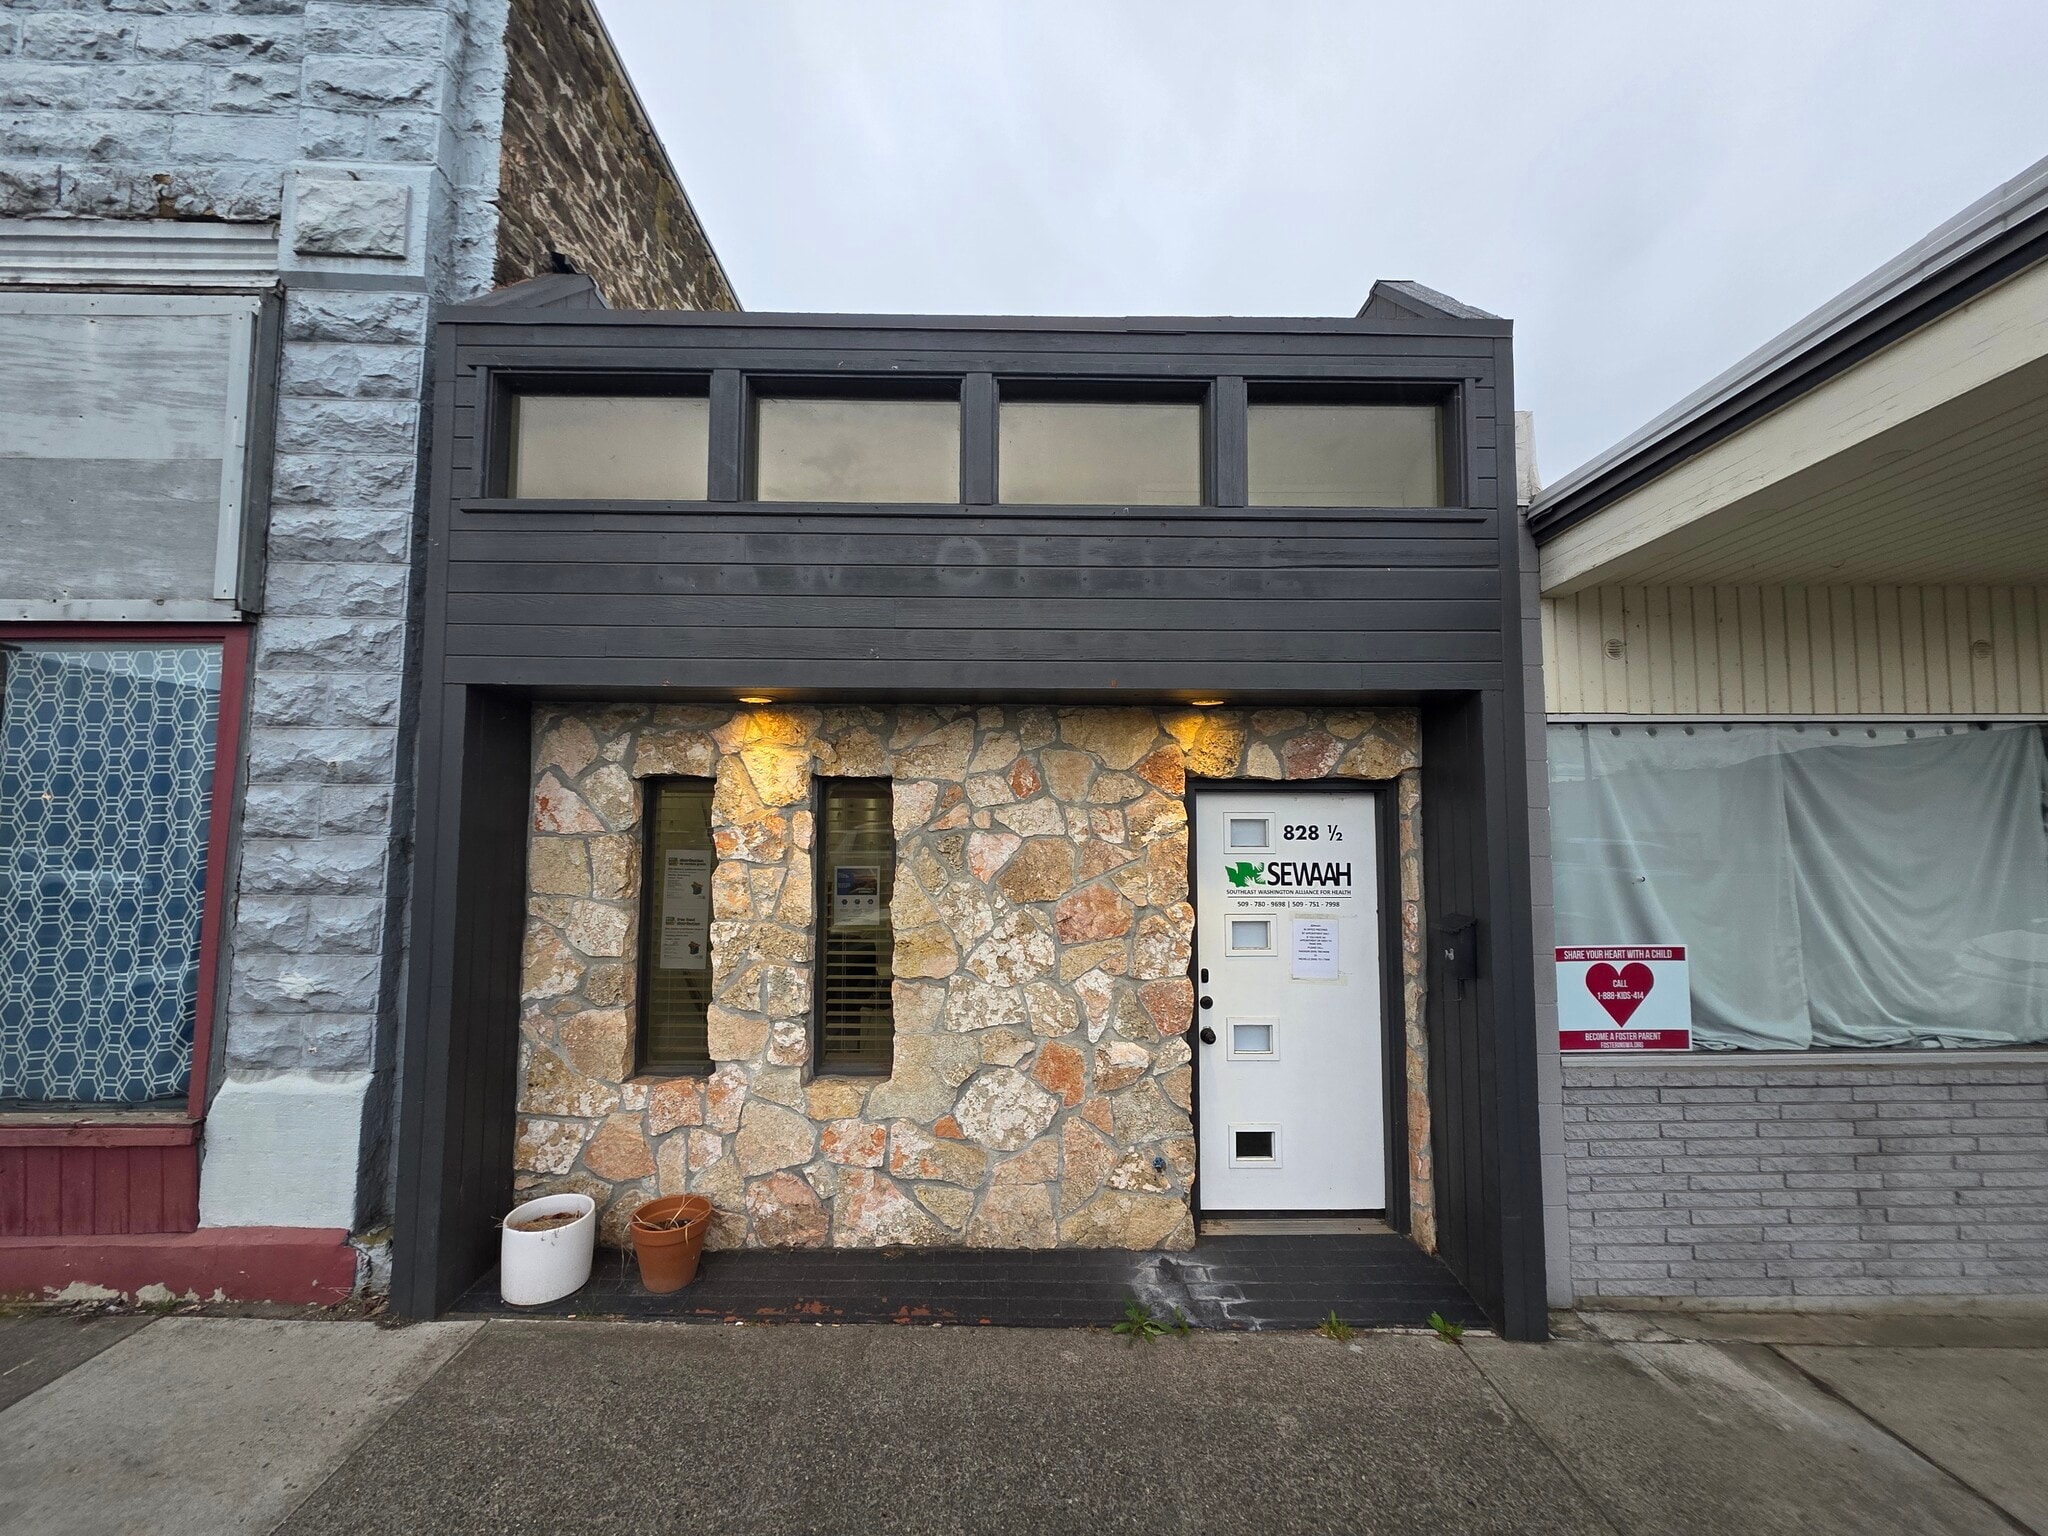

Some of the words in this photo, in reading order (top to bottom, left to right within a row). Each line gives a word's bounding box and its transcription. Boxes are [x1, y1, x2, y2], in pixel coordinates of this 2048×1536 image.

[1283, 825, 1320, 841] 828
[1267, 862, 1352, 887] SEWAAH
[1564, 950, 1585, 959] SHARE
[1586, 949, 1604, 959] YOUR
[1604, 949, 1626, 959] HEART
[1627, 949, 1645, 959] WITH
[1645, 949, 1651, 959] A
[1651, 949, 1672, 958] CHILD
[1612, 979, 1629, 988] CALL
[1597, 991, 1644, 999] 1-888-KIDS-414
[1584, 1032, 1609, 1041] BECOME
[1609, 1032, 1615, 1041] A
[1615, 1032, 1638, 1041] FOSTER
[1638, 1032, 1662, 1041] PARENT
